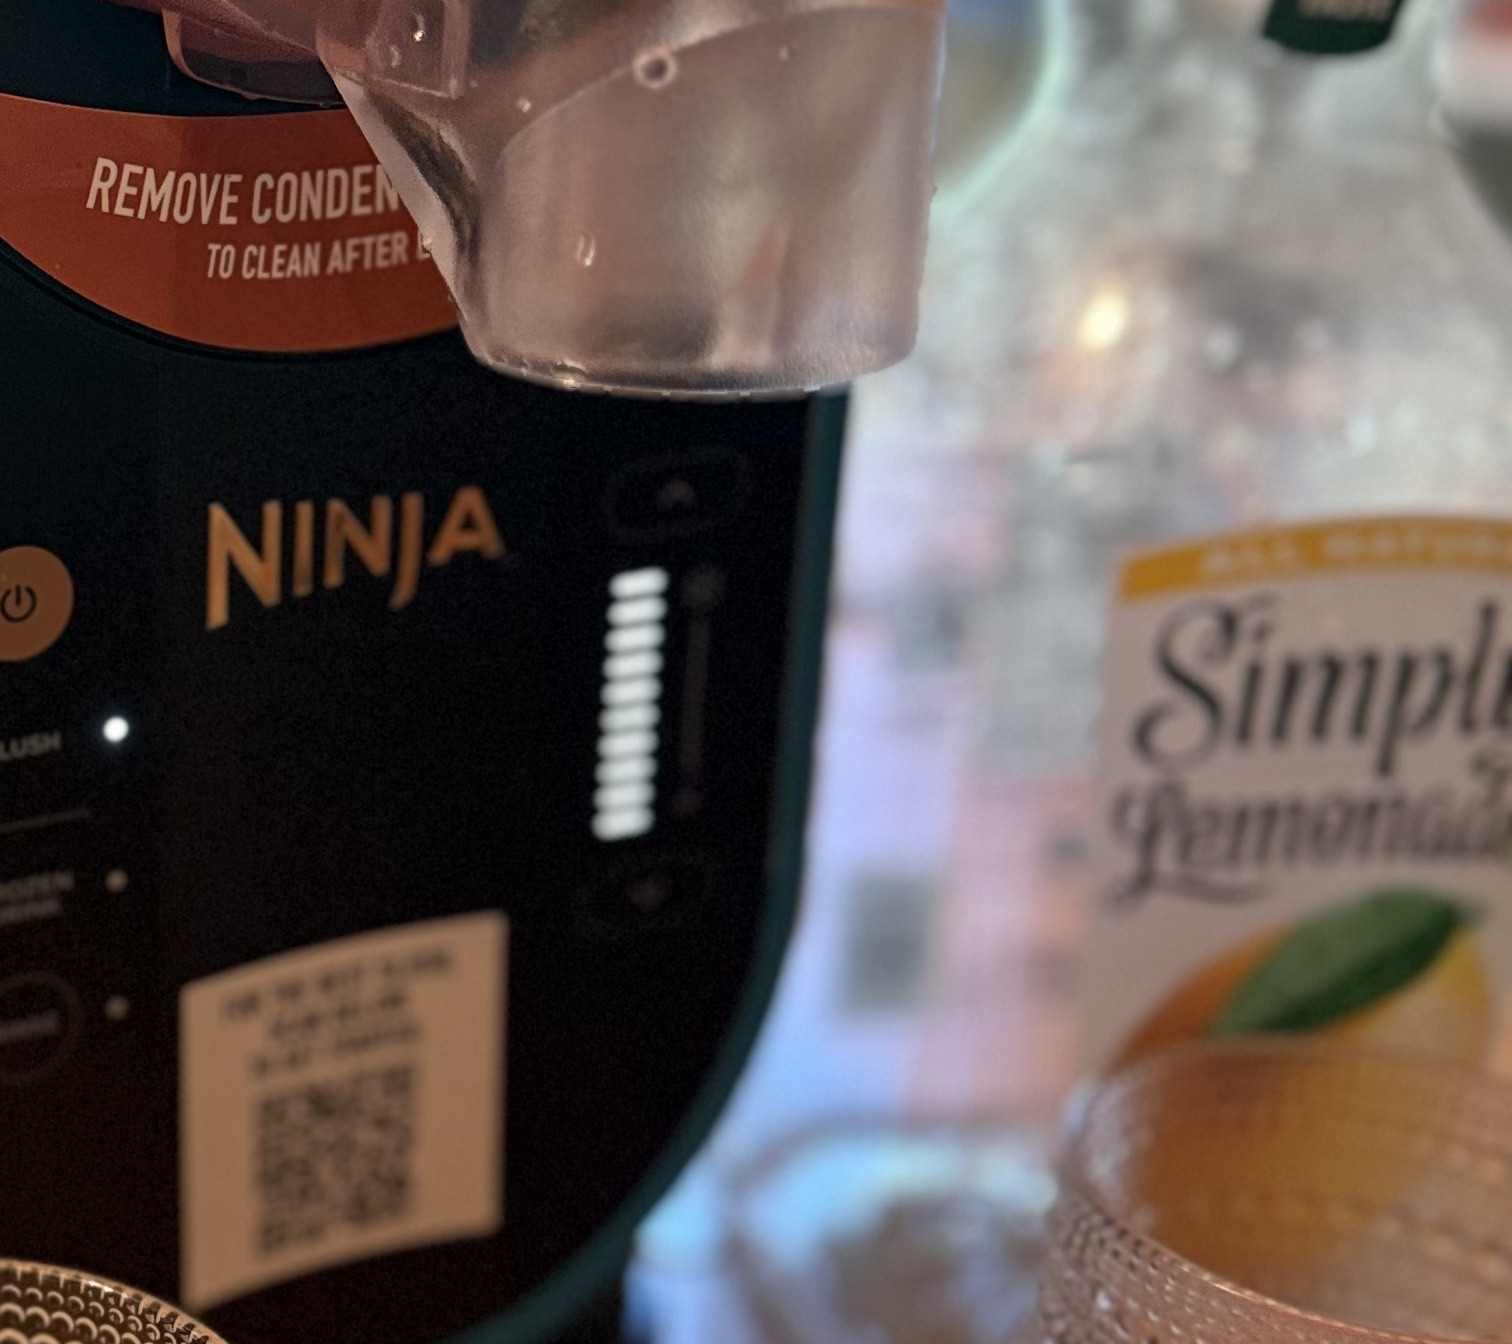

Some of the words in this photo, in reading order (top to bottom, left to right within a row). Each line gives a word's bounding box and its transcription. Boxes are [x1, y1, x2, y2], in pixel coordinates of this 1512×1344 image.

[85, 156, 244, 225] REMOVE
[206, 244, 236, 279] TO
[241, 242, 322, 280] CLEAN
[325, 231, 410, 275] AFTER
[204, 485, 508, 632] NINJA
